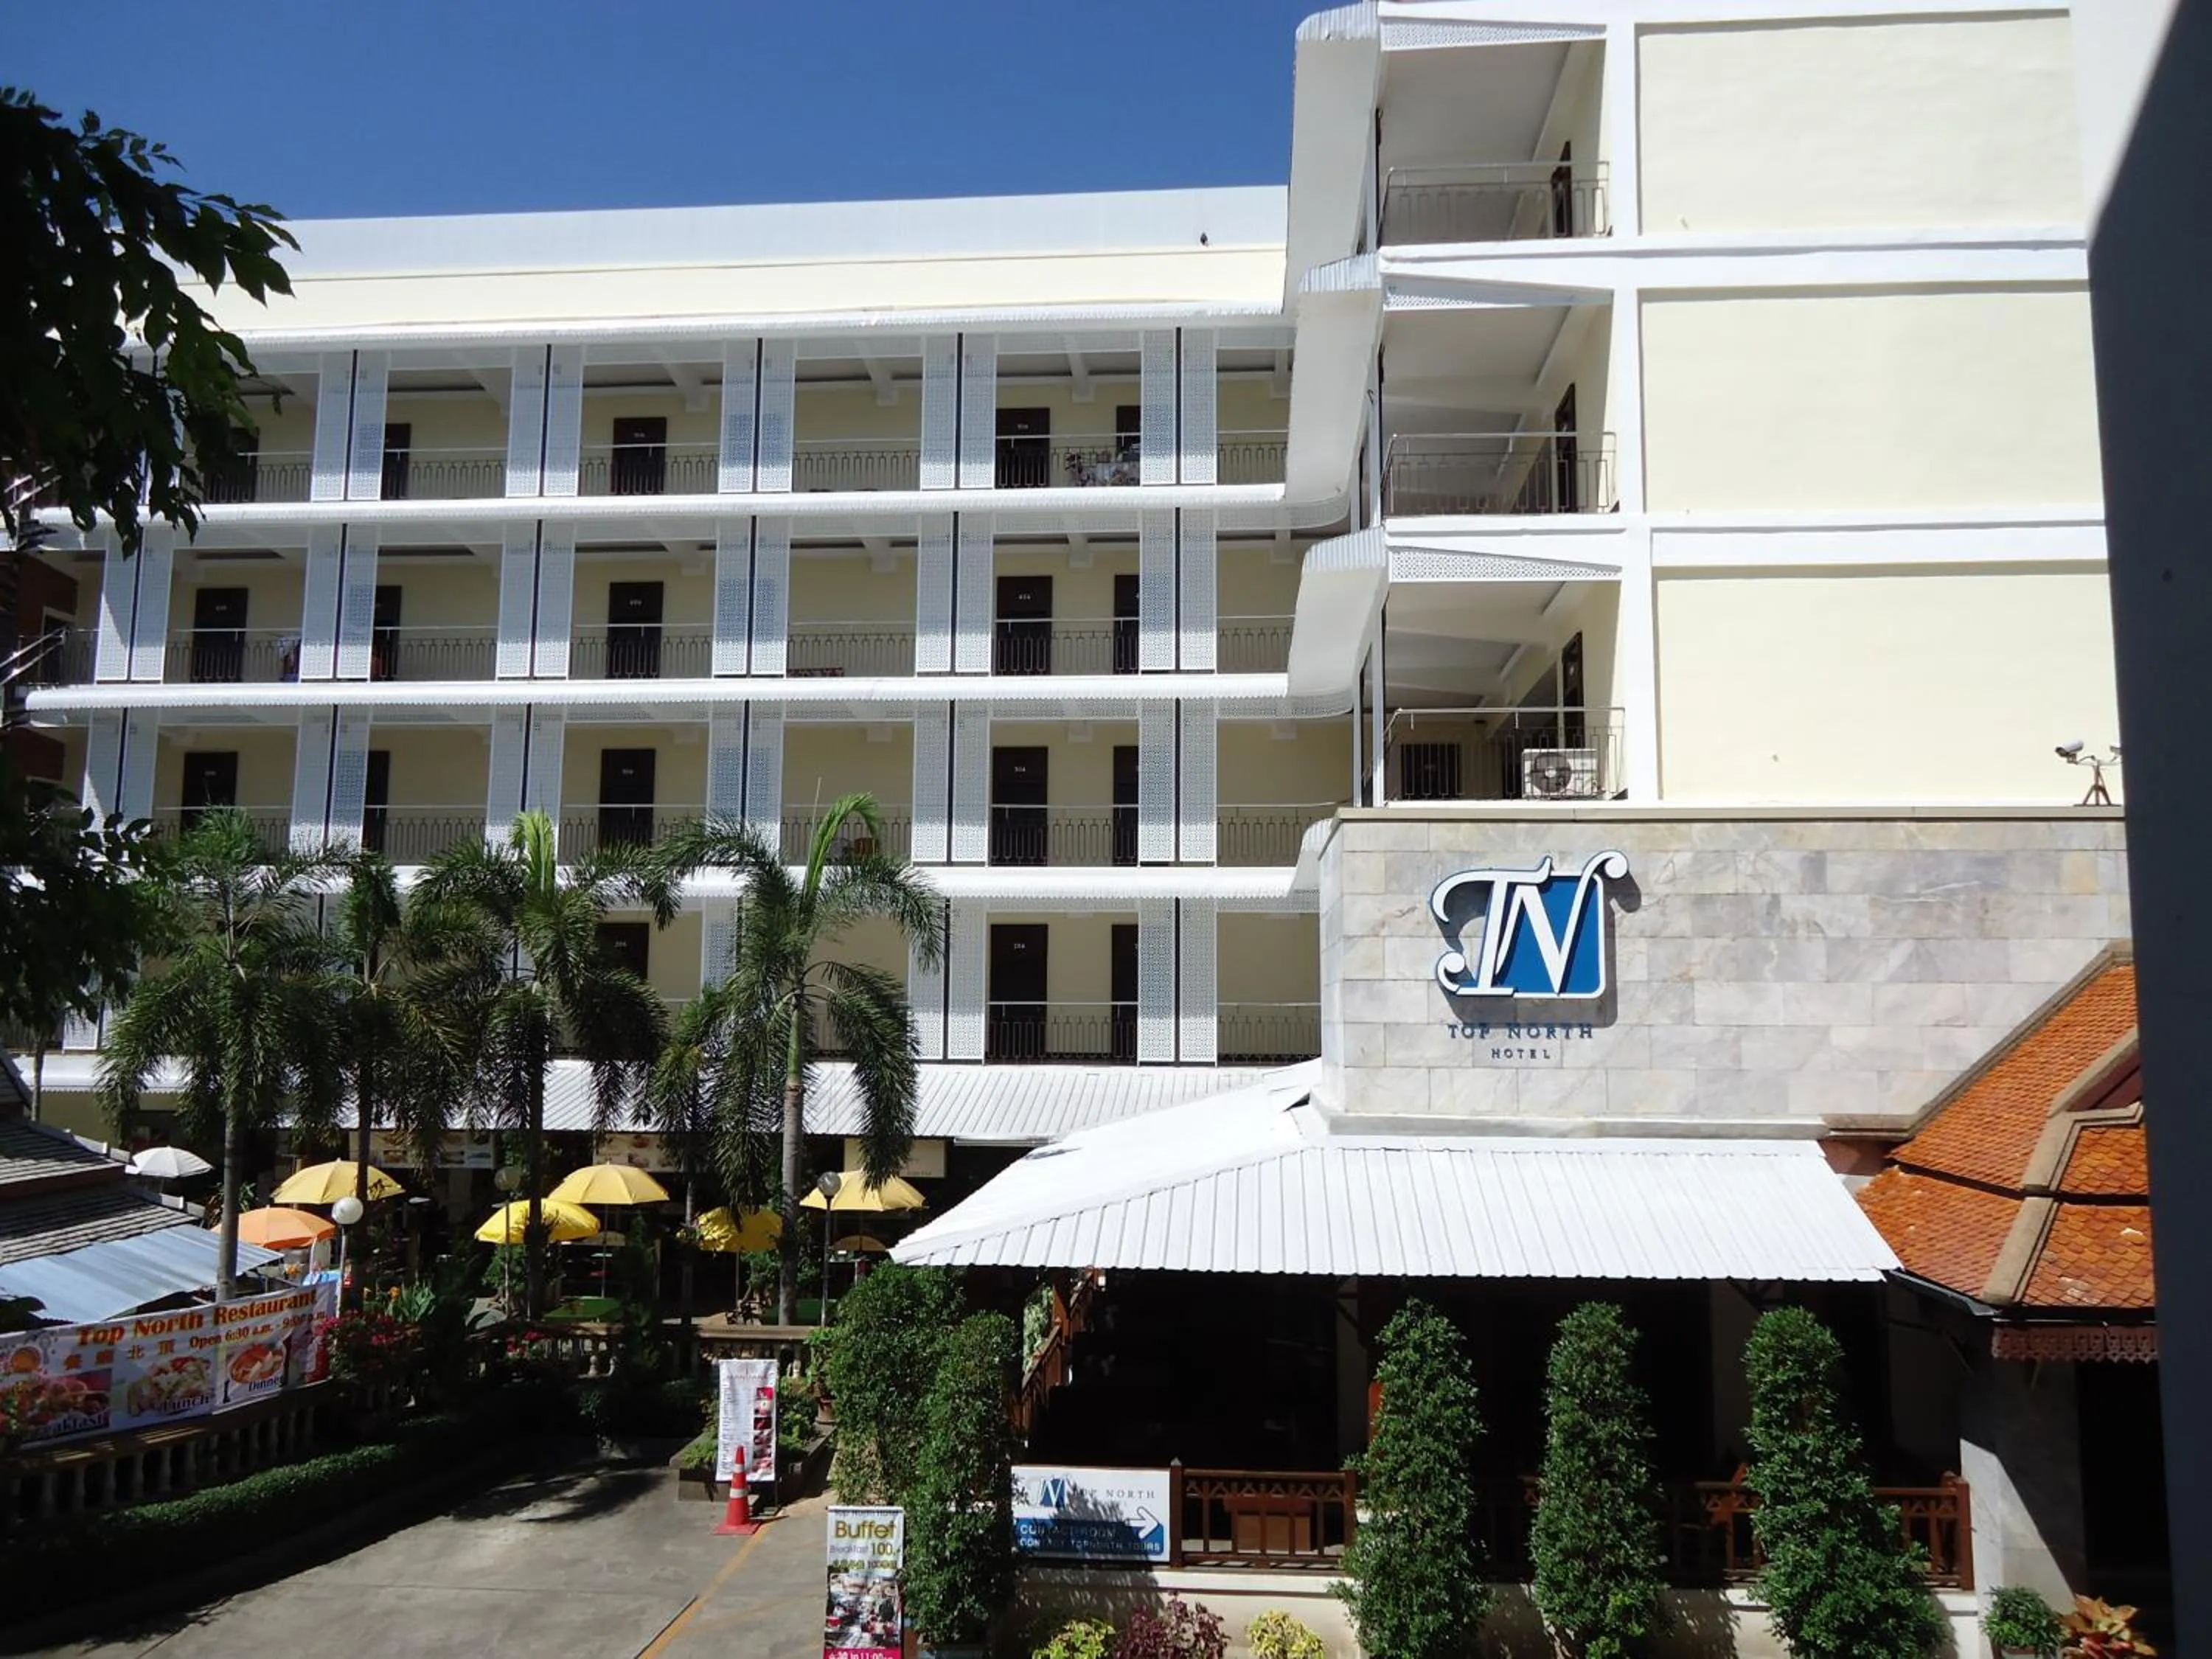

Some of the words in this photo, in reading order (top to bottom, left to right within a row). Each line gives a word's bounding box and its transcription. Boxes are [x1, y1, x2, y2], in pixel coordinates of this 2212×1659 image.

[1447, 1024, 1490, 1039] TOP
[1508, 1024, 1593, 1040] NORTH
[1491, 1048, 1551, 1059] HOTEL
[77, 1326, 125, 1346] Top
[134, 1311, 204, 1338] North
[213, 1290, 316, 1325] Restaurant
[189, 1335, 221, 1349] Open
[1106, 1489, 1155, 1499] NORTH
[835, 1520, 897, 1538] Buffet
